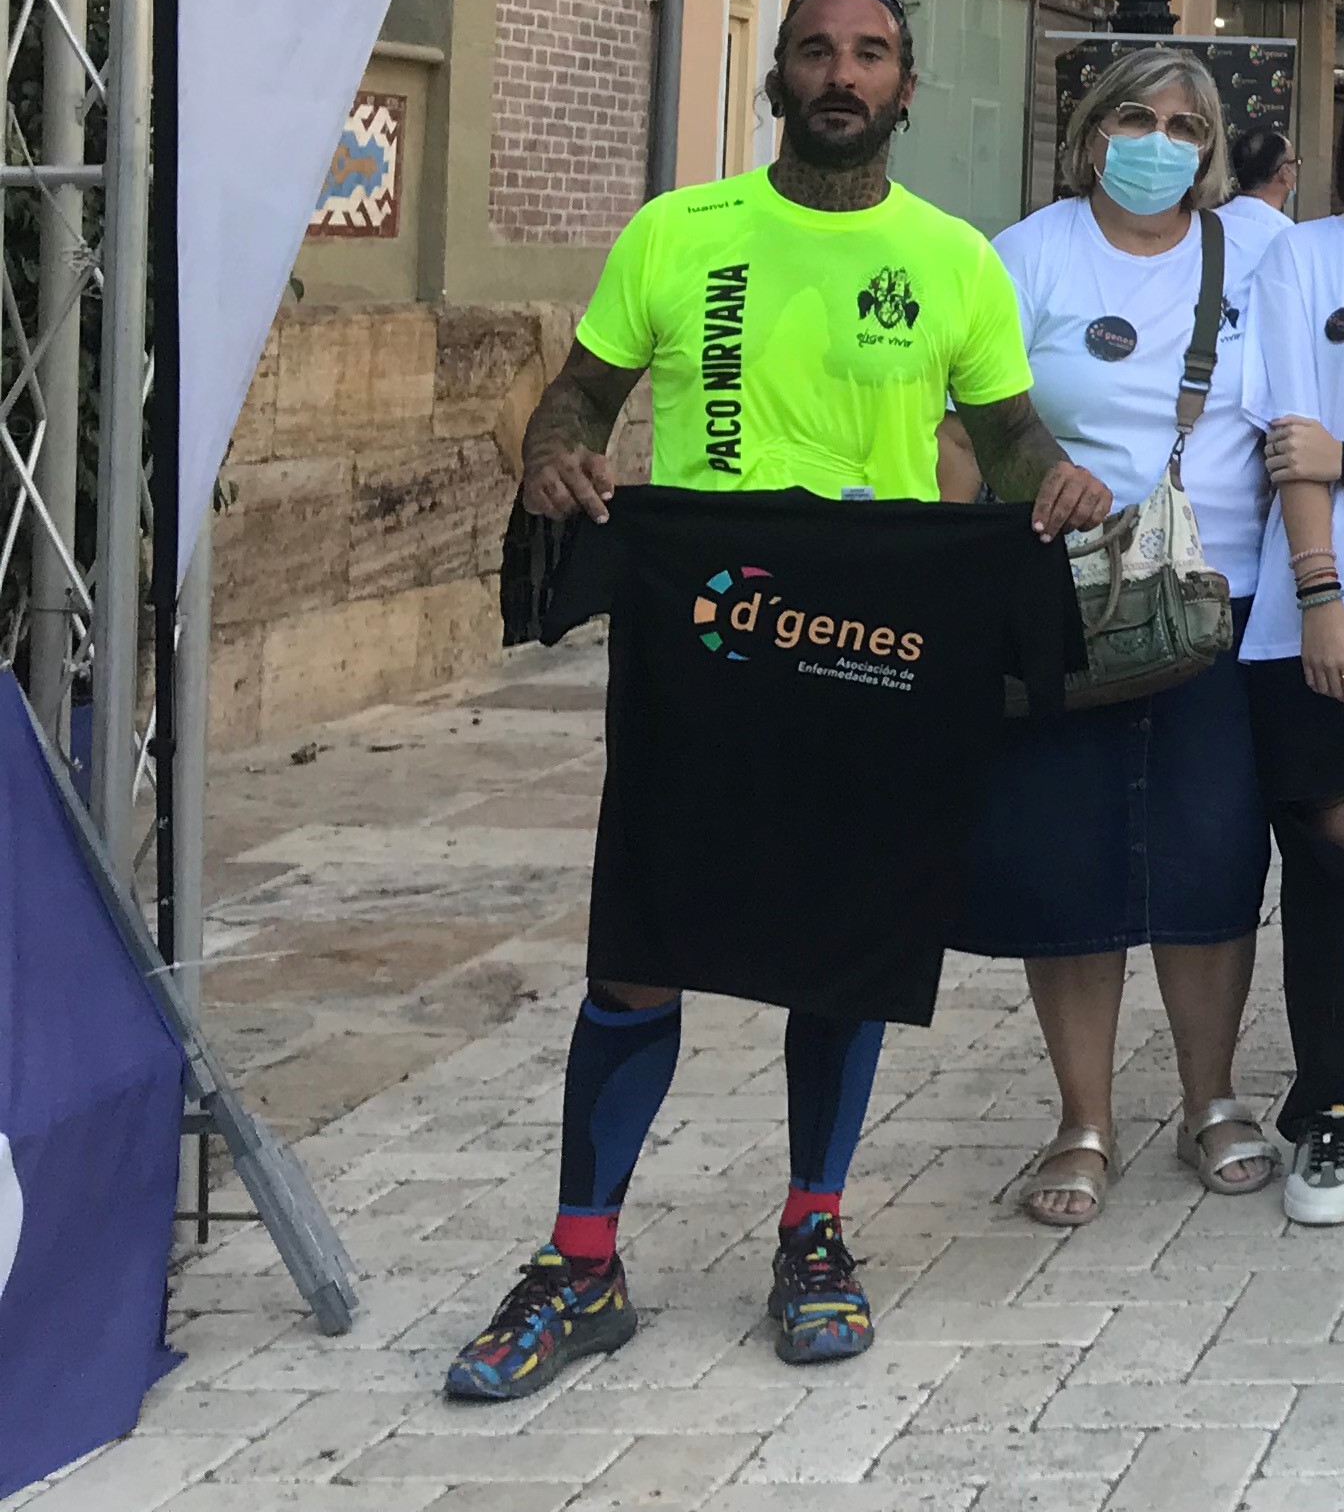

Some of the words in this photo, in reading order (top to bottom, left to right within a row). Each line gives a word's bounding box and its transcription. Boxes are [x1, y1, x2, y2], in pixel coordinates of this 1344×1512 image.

[702, 263, 750, 391] NIRVANA
[705, 400, 742, 475] PACO
[798, 661, 878, 685] Enfermedades
[881, 676, 912, 691] Raras
[836, 657, 896, 676] Asociación
[899, 668, 915, 681] de
